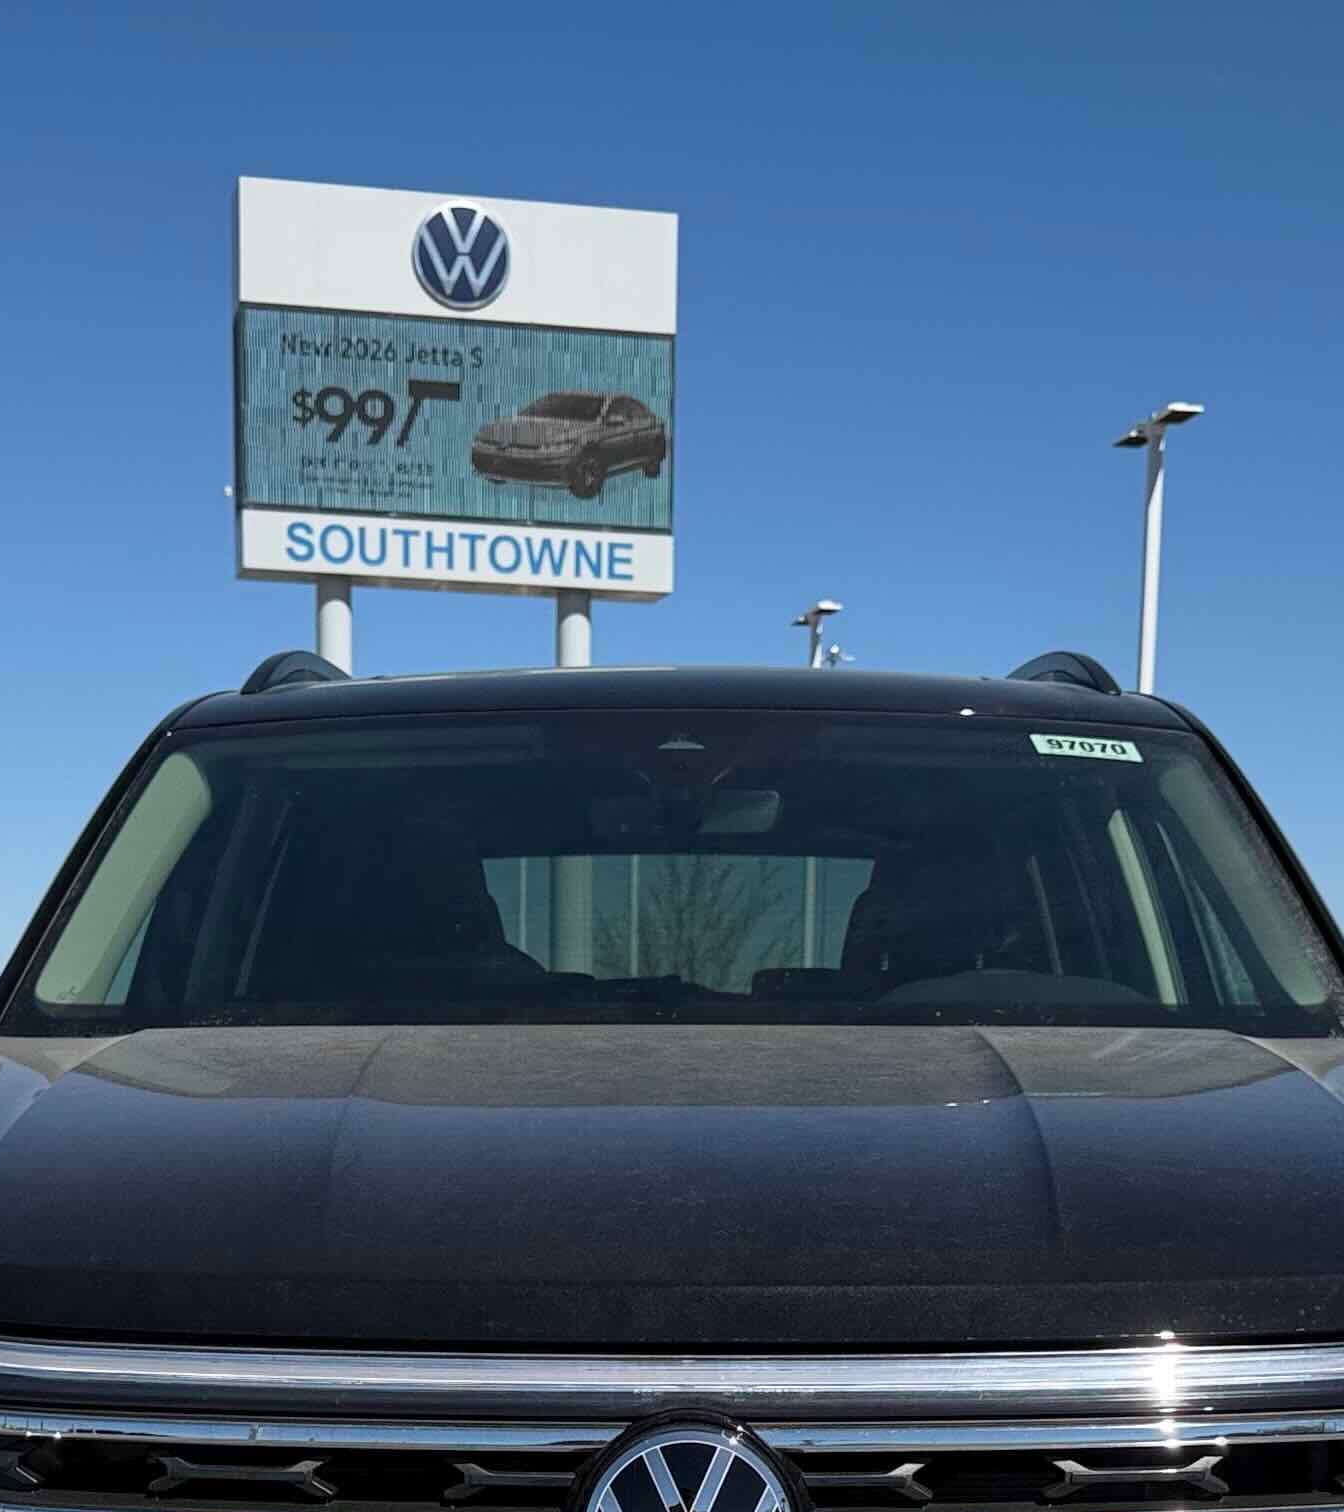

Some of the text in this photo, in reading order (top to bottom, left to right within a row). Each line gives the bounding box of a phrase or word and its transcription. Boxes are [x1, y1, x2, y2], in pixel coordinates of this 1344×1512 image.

[415, 202, 509, 304] VW
[340, 337, 397, 363] 2026
[406, 343, 464, 368] Jetta
[470, 346, 484, 369] S
[285, 521, 635, 582] SOUTHTOWNE
[1046, 738, 1128, 755] 97070
